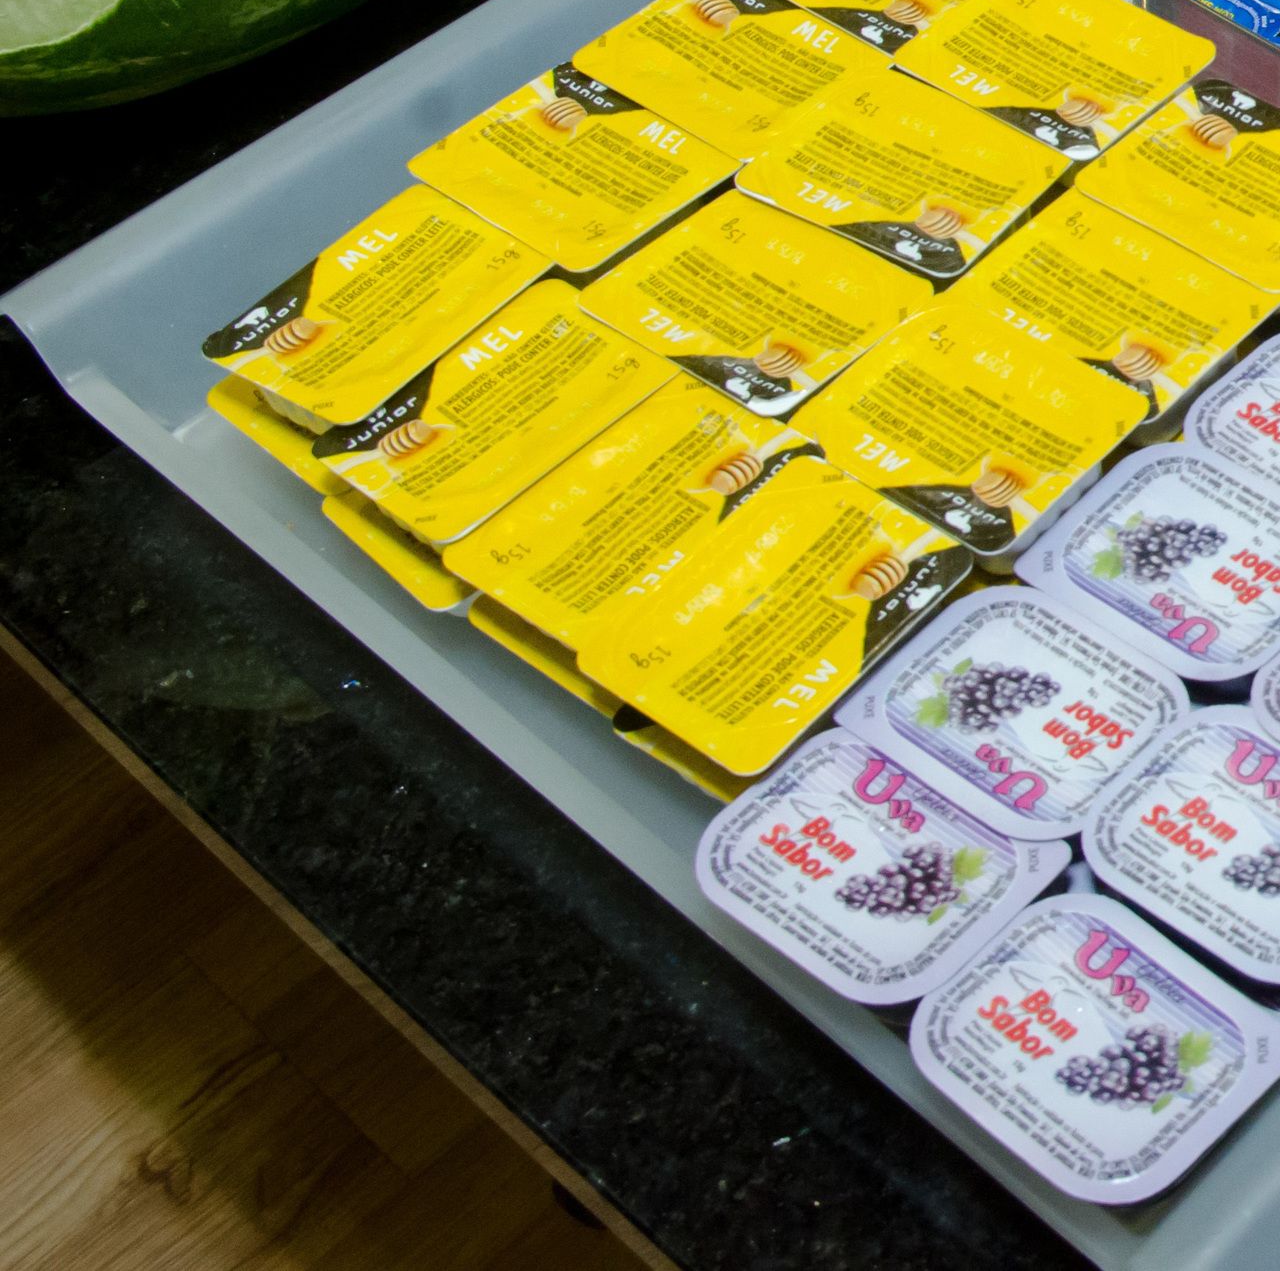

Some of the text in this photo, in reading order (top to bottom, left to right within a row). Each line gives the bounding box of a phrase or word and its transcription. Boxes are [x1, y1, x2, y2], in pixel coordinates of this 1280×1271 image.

[792, 20, 840, 54] MEL
[949, 64, 999, 95] MEL
[639, 120, 687, 155] MEL
[796, 181, 852, 212] MEL
[336, 229, 398, 271] MEL
[459, 325, 524, 371] MEL
[640, 308, 694, 342] MEL
[853, 434, 910, 473] MEL
[1212, 567, 1262, 604] Bom
[1150, 592, 1219, 654] Uva
[772, 658, 839, 710] MEL
[1042, 718, 1097, 760] Bom
[1063, 701, 1135, 749] Sabor
[853, 758, 925, 833] Uva
[975, 743, 1047, 811] Uva
[800, 816, 856, 863] Bom
[1141, 805, 1219, 862] Sabor
[1180, 796, 1238, 843] Bom
[759, 823, 833, 881] Sabor
[1075, 930, 1150, 1013] Uva
[977, 995, 1055, 1060] Sabor
[1019, 990, 1079, 1042] Bom
